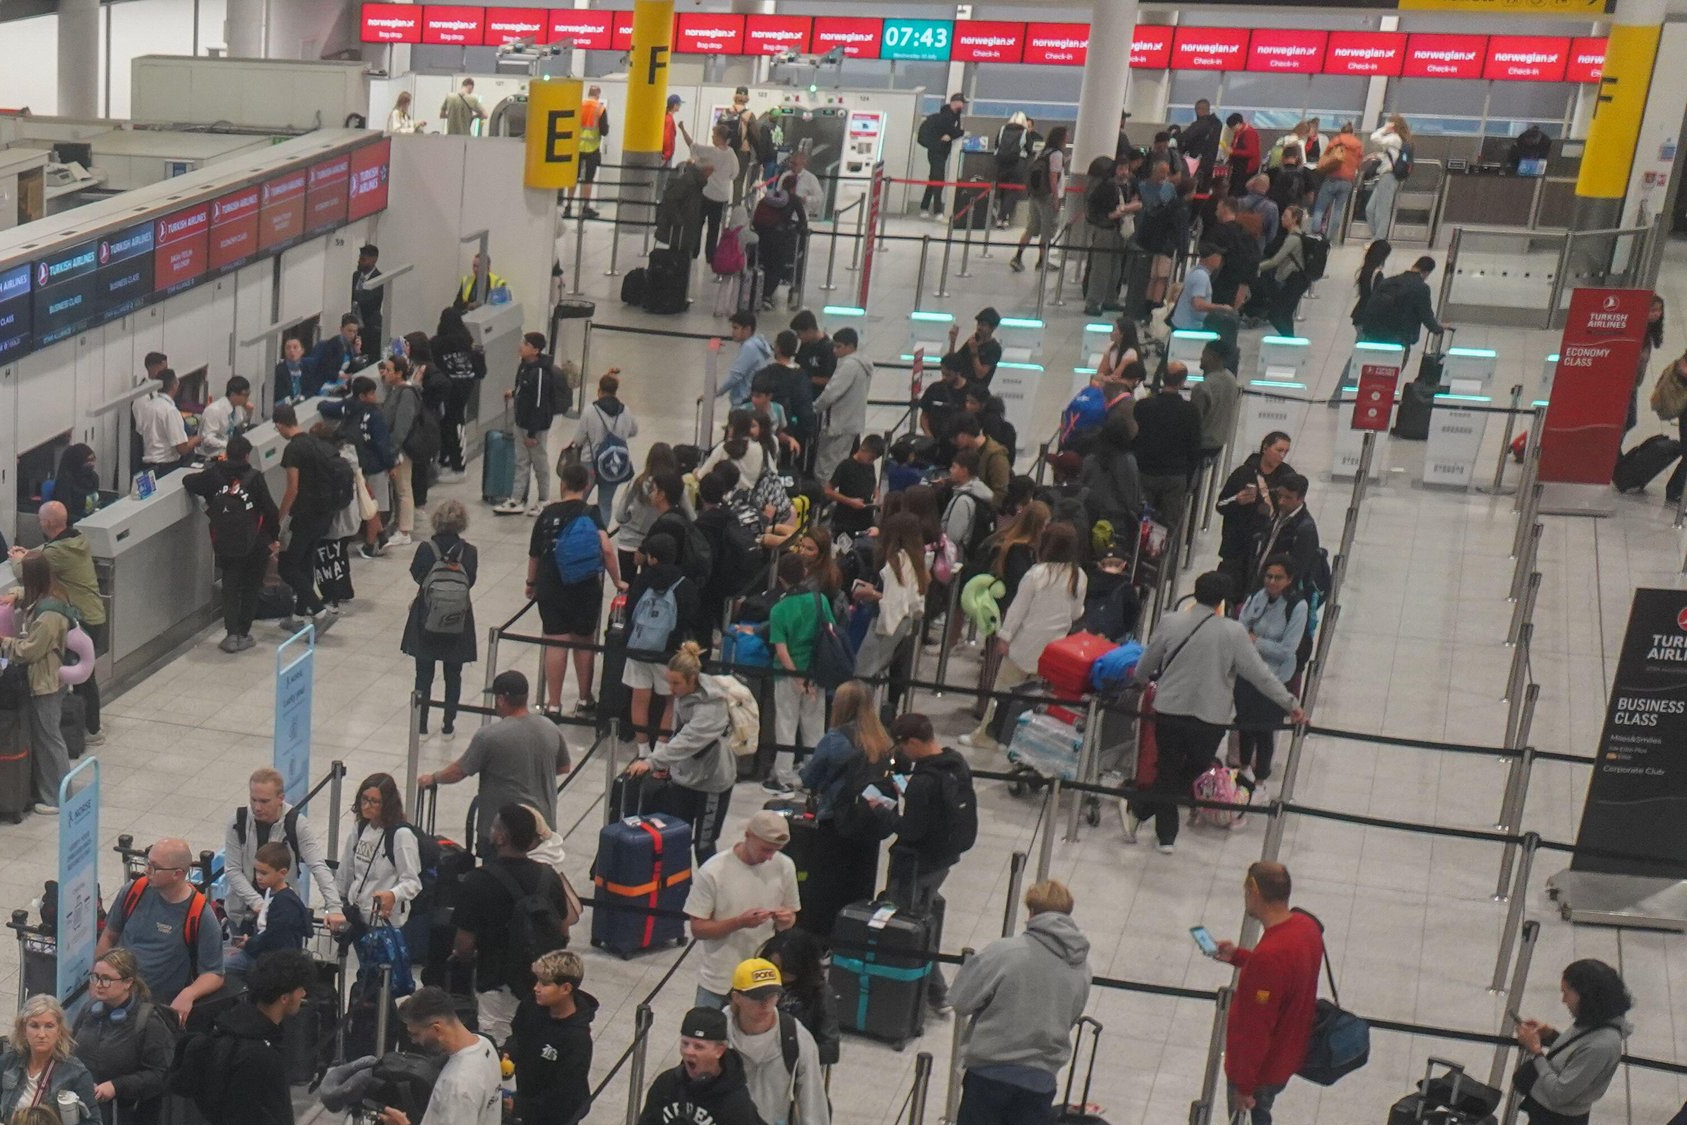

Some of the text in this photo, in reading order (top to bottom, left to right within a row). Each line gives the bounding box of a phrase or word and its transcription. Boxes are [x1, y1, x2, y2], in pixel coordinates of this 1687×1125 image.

[367, 18, 407, 29] norwegian
[429, 20, 469, 31] norwegian
[491, 22, 532, 32] norwegian
[555, 24, 596, 34] norwegian
[685, 28, 728, 38] norwegian
[751, 30, 795, 41] norwegian
[820, 32, 864, 42] norwegian
[885, 26, 947, 48] 07:43
[960, 35, 1007, 47] norwegian
[1032, 38, 1080, 49] norwegian
[1181, 43, 1229, 55] norwegian
[1257, 45, 1307, 56] norwegian
[1335, 47, 1385, 59] norwegian
[1414, 50, 1466, 61] norwegian
[1495, 52, 1548, 64] norwegian
[648, 46, 669, 85] F
[545, 110, 575, 162] E
[168, 212, 207, 233] TURKISH AIRLINES
[49, 251, 95, 276] TURKISH AIRLINES
[3, 274, 27, 290] AIRLINES
[0, 314, 14, 327] CLASS
[1590, 313, 1629, 322] TURKISH
[1587, 320, 1627, 329] AIRLINES
[1566, 347, 1611, 358] ECONOMY
[1564, 357, 1593, 367] CLASS
[317, 541, 341, 562] FLY
[1617, 697, 1685, 714] BUSINESS
[1614, 711, 1658, 727] CLASS
[1603, 764, 1664, 776] Corporate Club
